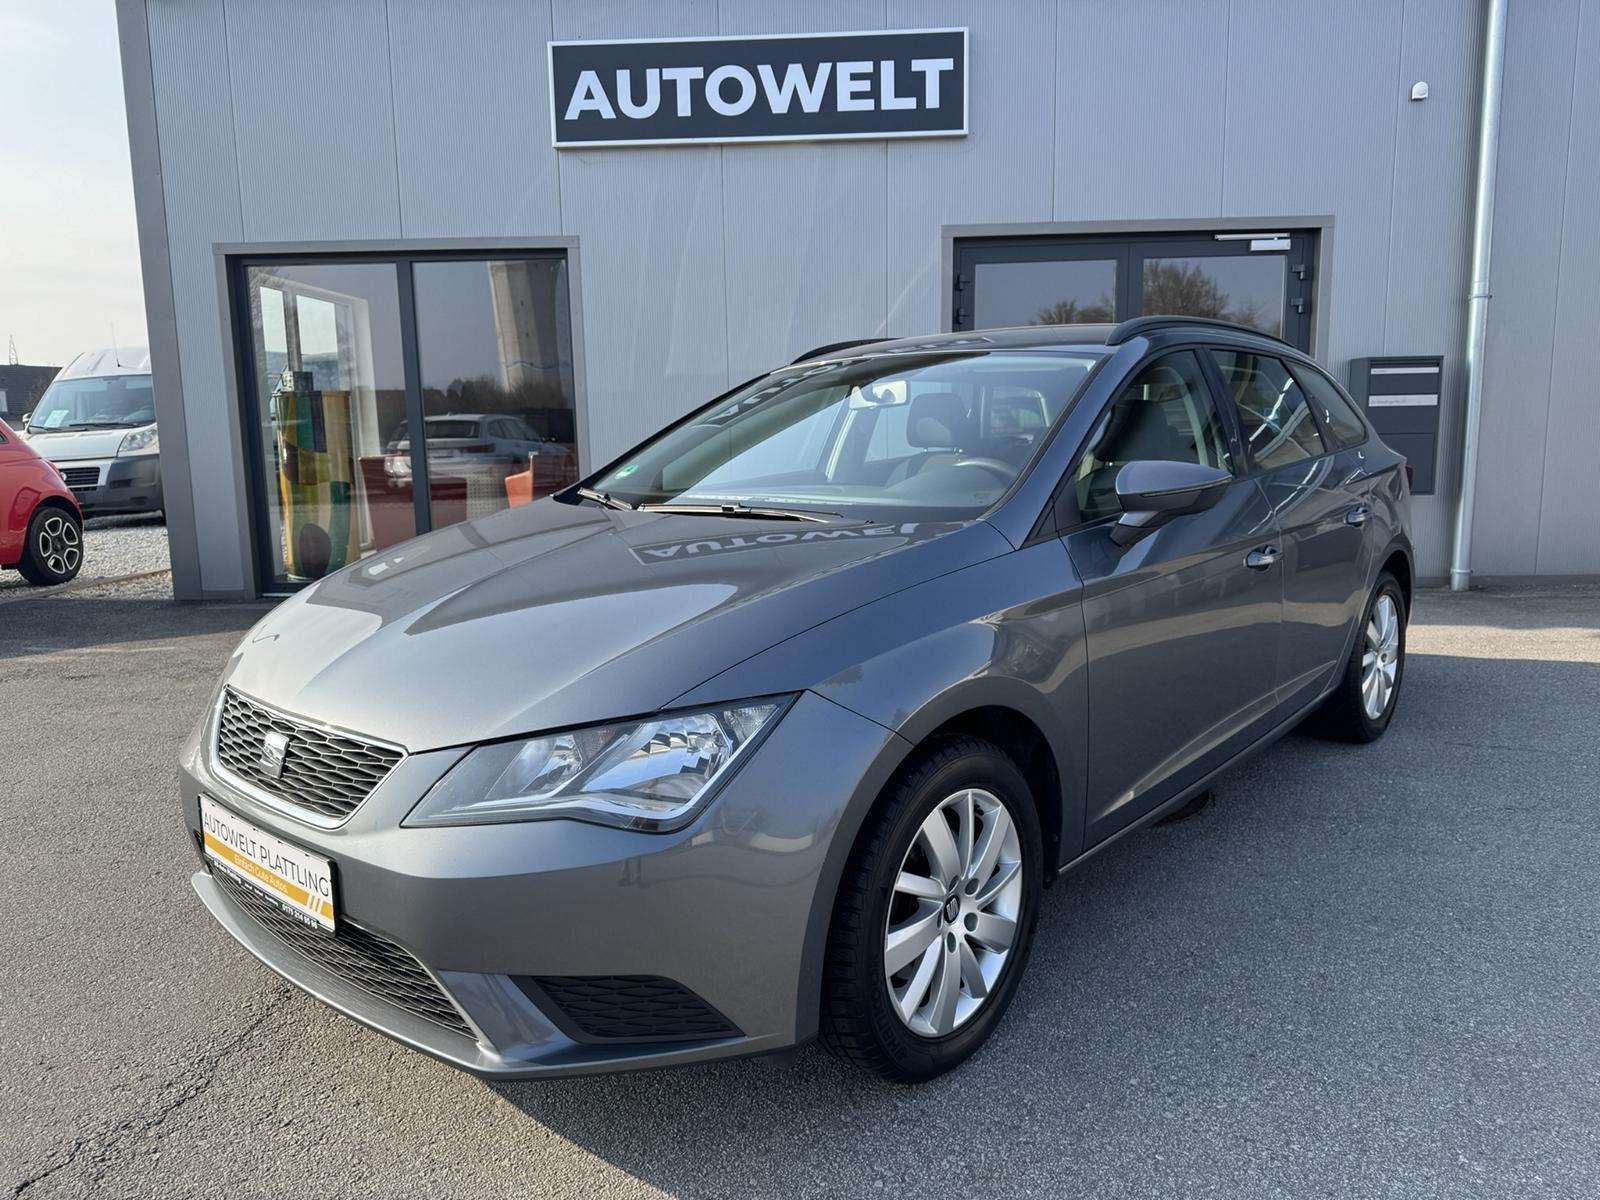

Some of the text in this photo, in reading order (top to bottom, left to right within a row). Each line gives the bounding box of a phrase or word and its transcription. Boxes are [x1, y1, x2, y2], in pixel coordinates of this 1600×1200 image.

[564, 57, 954, 121] AUTOWELT
[203, 812, 257, 858] AUTOWELT
[260, 845, 329, 897] PLATTLING
